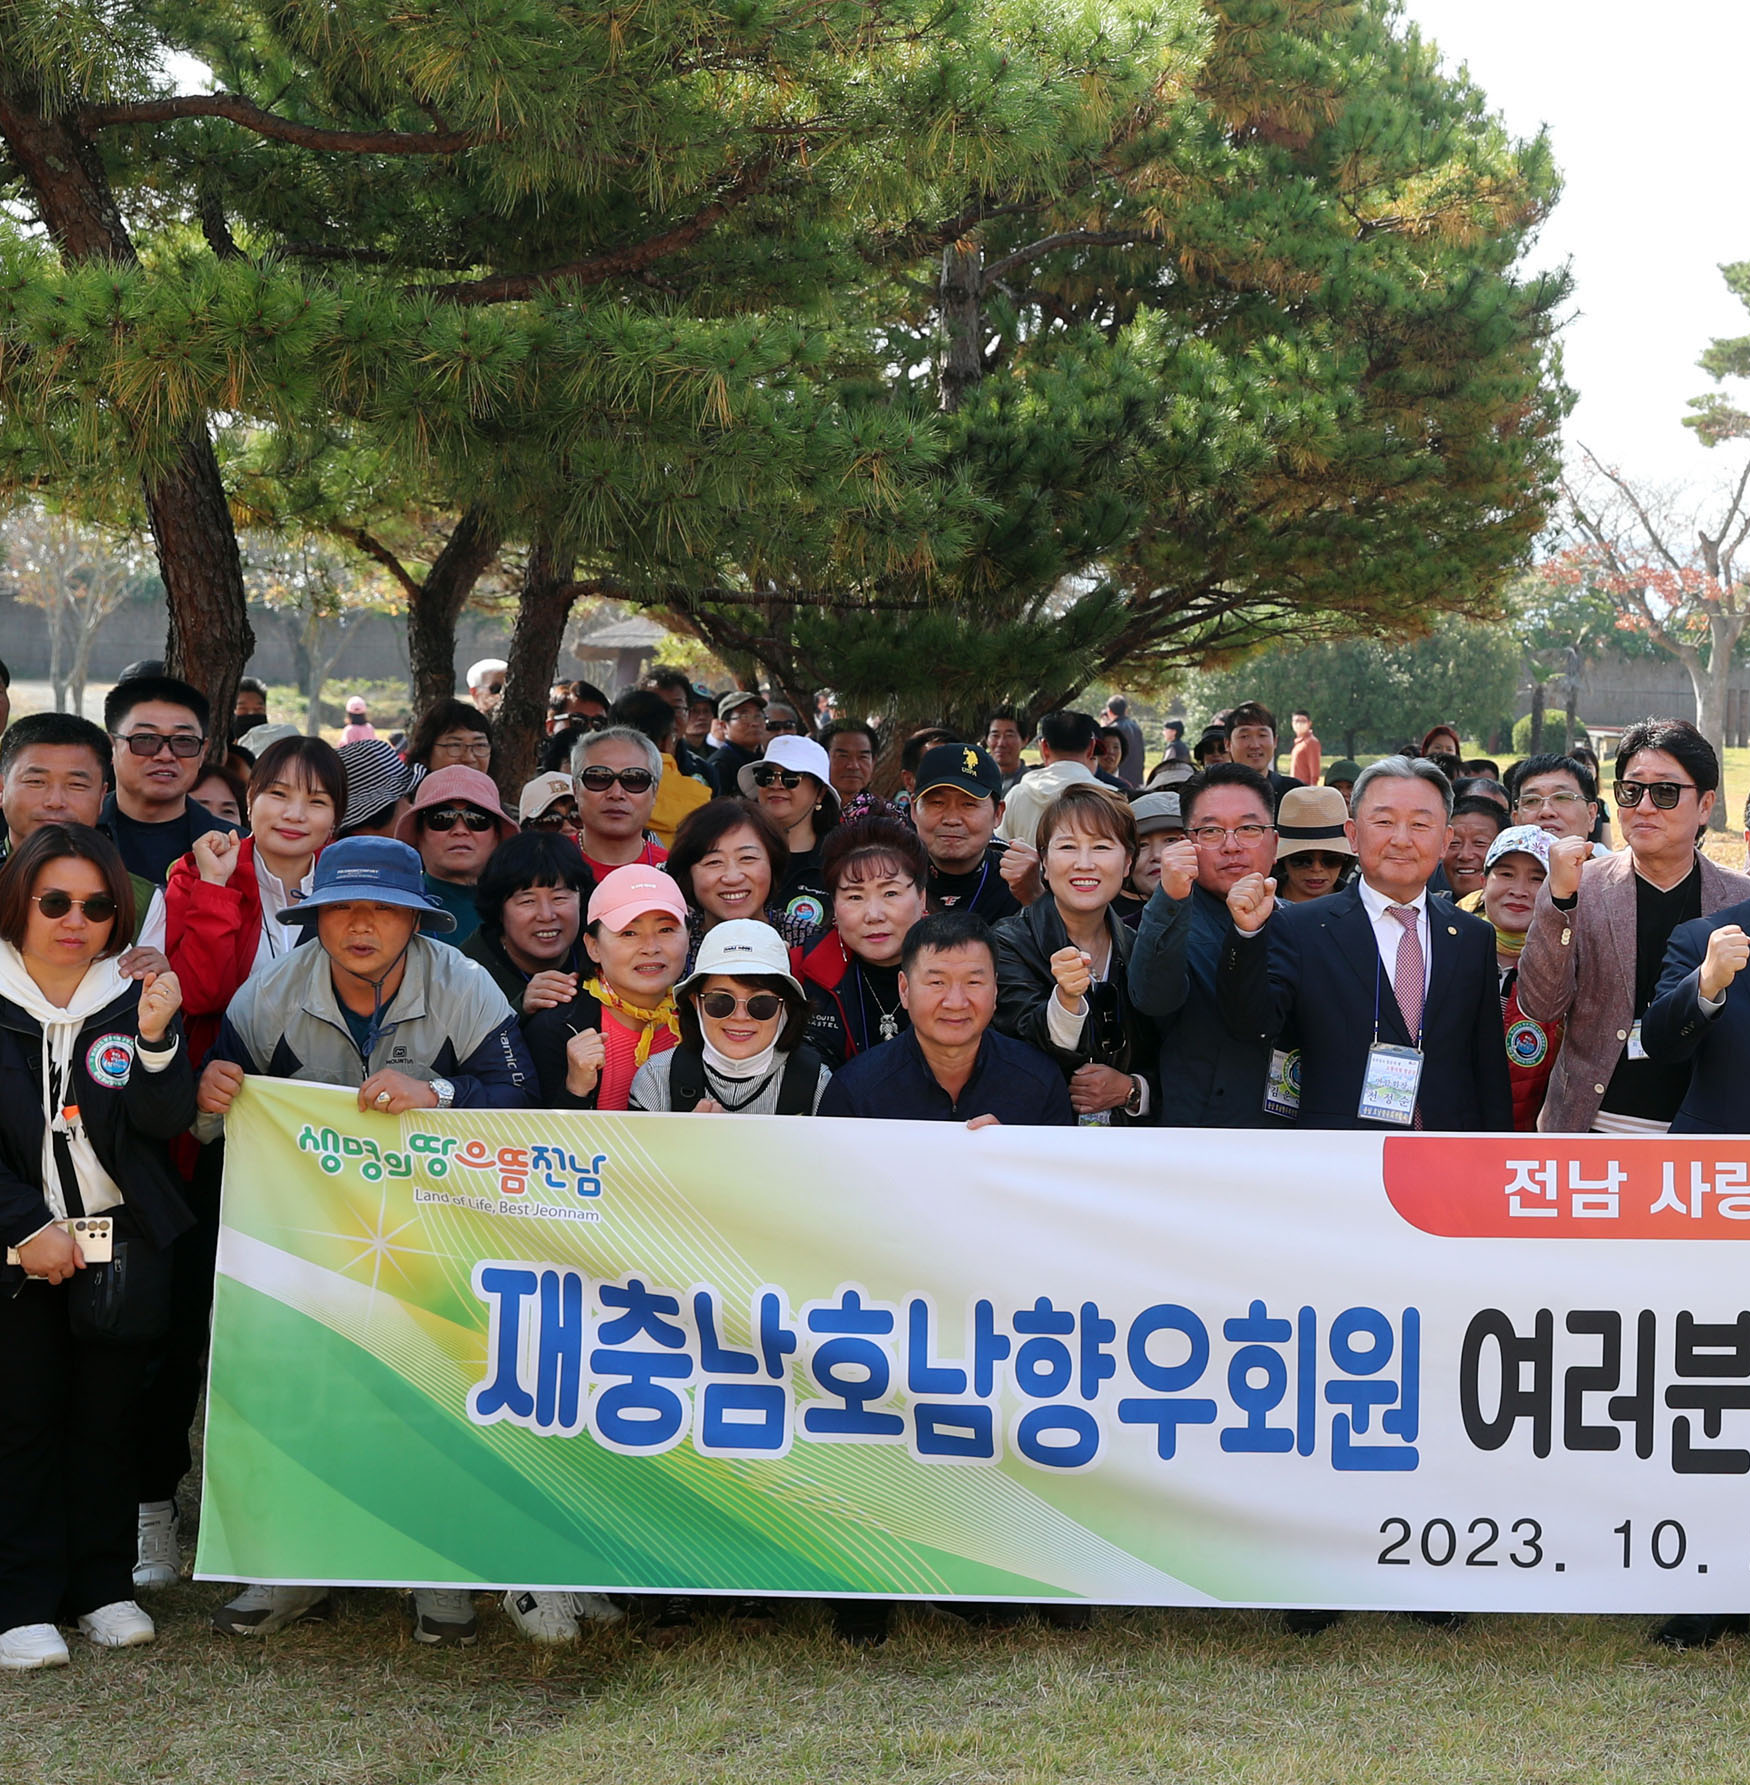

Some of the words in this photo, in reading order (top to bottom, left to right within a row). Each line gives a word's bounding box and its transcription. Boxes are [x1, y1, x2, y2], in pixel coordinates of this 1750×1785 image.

[807, 1019, 839, 1030] ASTEL
[415, 1188, 450, 1204] Land
[453, 1195, 468, 1206] of
[469, 1199, 496, 1215] Life,
[499, 1201, 530, 1216] Best
[533, 1203, 600, 1222] Jeonnam
[1504, 1159, 1628, 1219] 전남
[476, 1267, 1420, 1471] 재충남호남향우회원
[1378, 1517, 1565, 1572] 2023.
[1614, 1519, 1708, 1574] 10.
